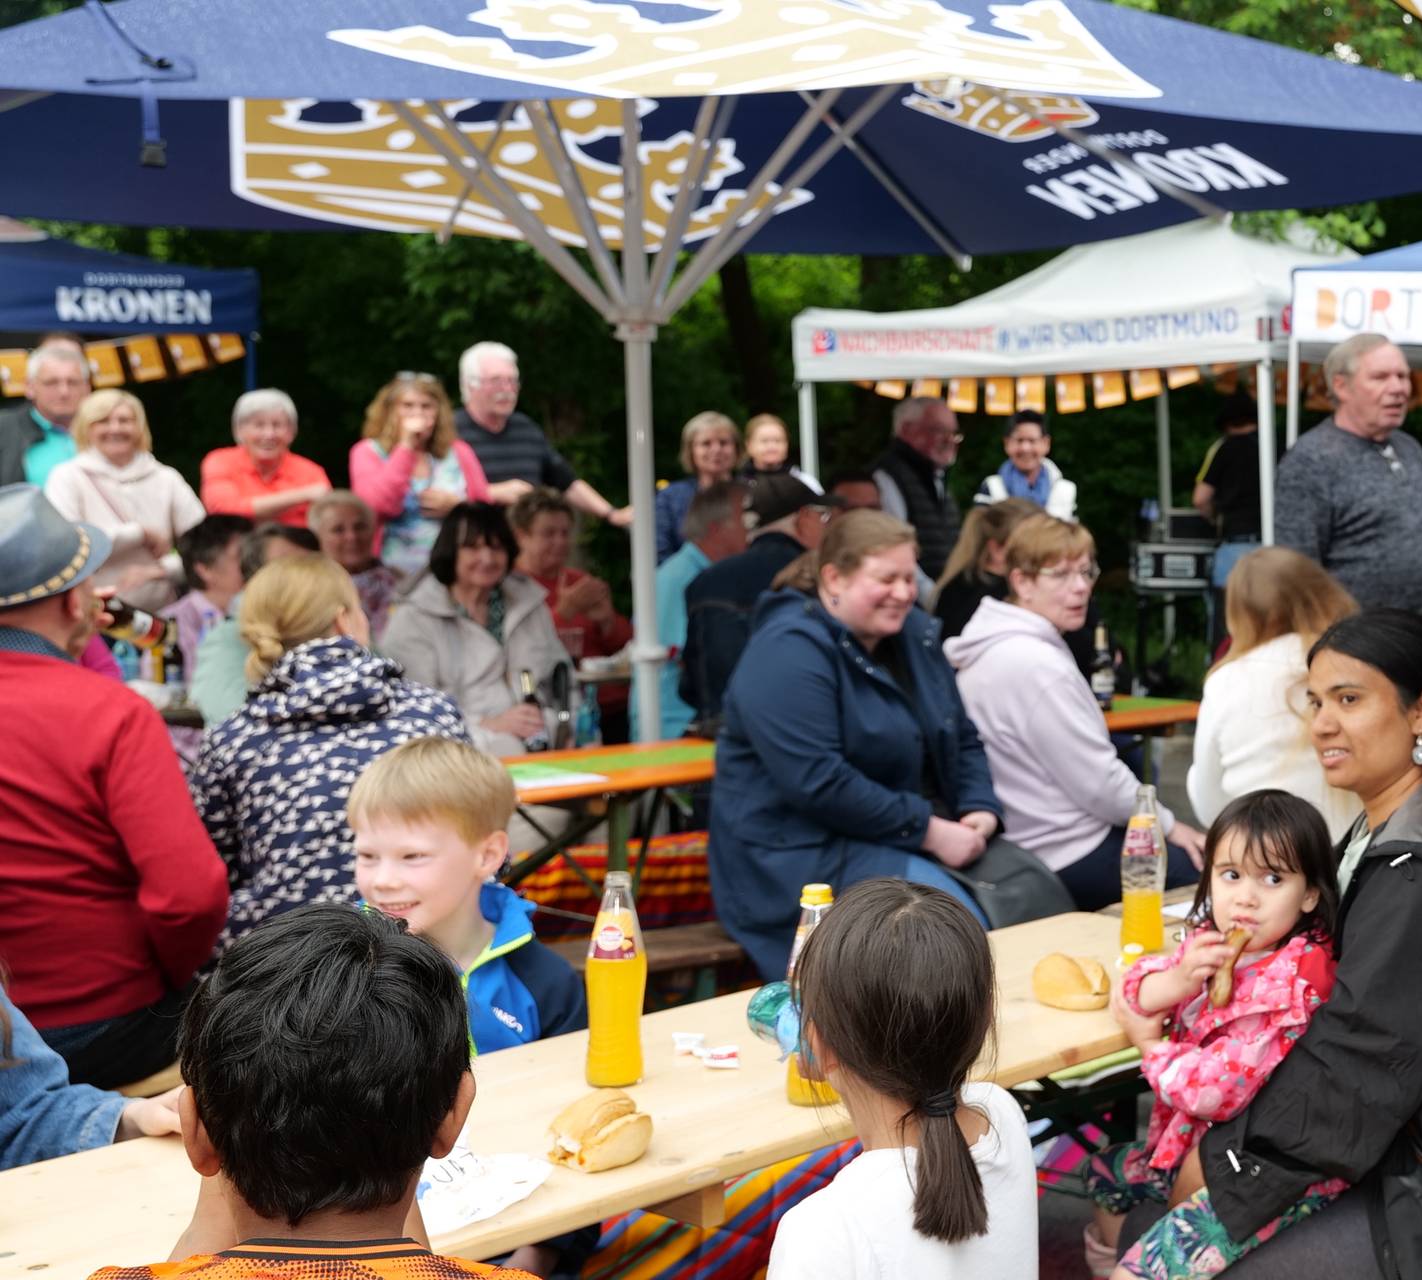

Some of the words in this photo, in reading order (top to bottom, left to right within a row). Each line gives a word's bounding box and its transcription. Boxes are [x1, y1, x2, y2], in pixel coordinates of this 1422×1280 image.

[55, 286, 213, 324] KRONEN
[1060, 318, 1109, 346] SIND
[1114, 306, 1239, 341] DORTMUND
